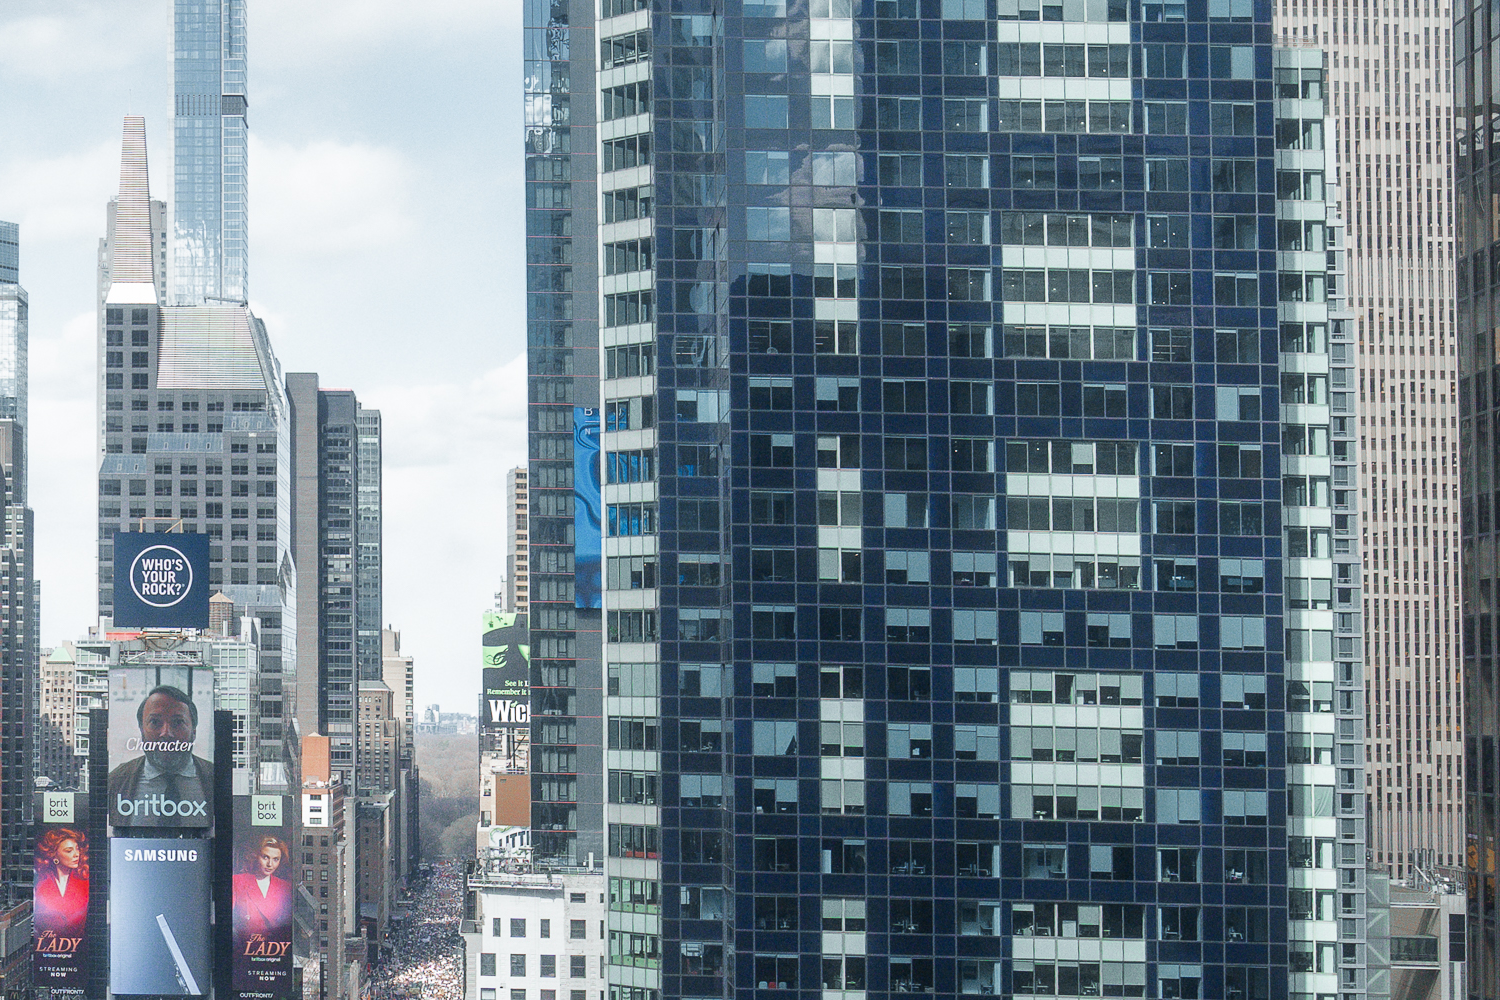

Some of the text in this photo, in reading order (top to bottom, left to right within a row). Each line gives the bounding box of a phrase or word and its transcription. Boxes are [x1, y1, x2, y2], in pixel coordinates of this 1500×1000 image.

[141, 558, 184, 571] WHO'S
[142, 571, 176, 583] YOUR
[126, 737, 196, 752] Character
[49, 797, 68, 807] brit
[117, 793, 207, 817] britbox
[257, 800, 276, 811] brit
[49, 807, 69, 817] box
[257, 810, 277, 820] box
[124, 849, 198, 862] SAMSUNG
[41, 930, 56, 938] The
[249, 933, 265, 942] The
[35, 937, 82, 953] LADY
[243, 941, 291, 956] LADY
